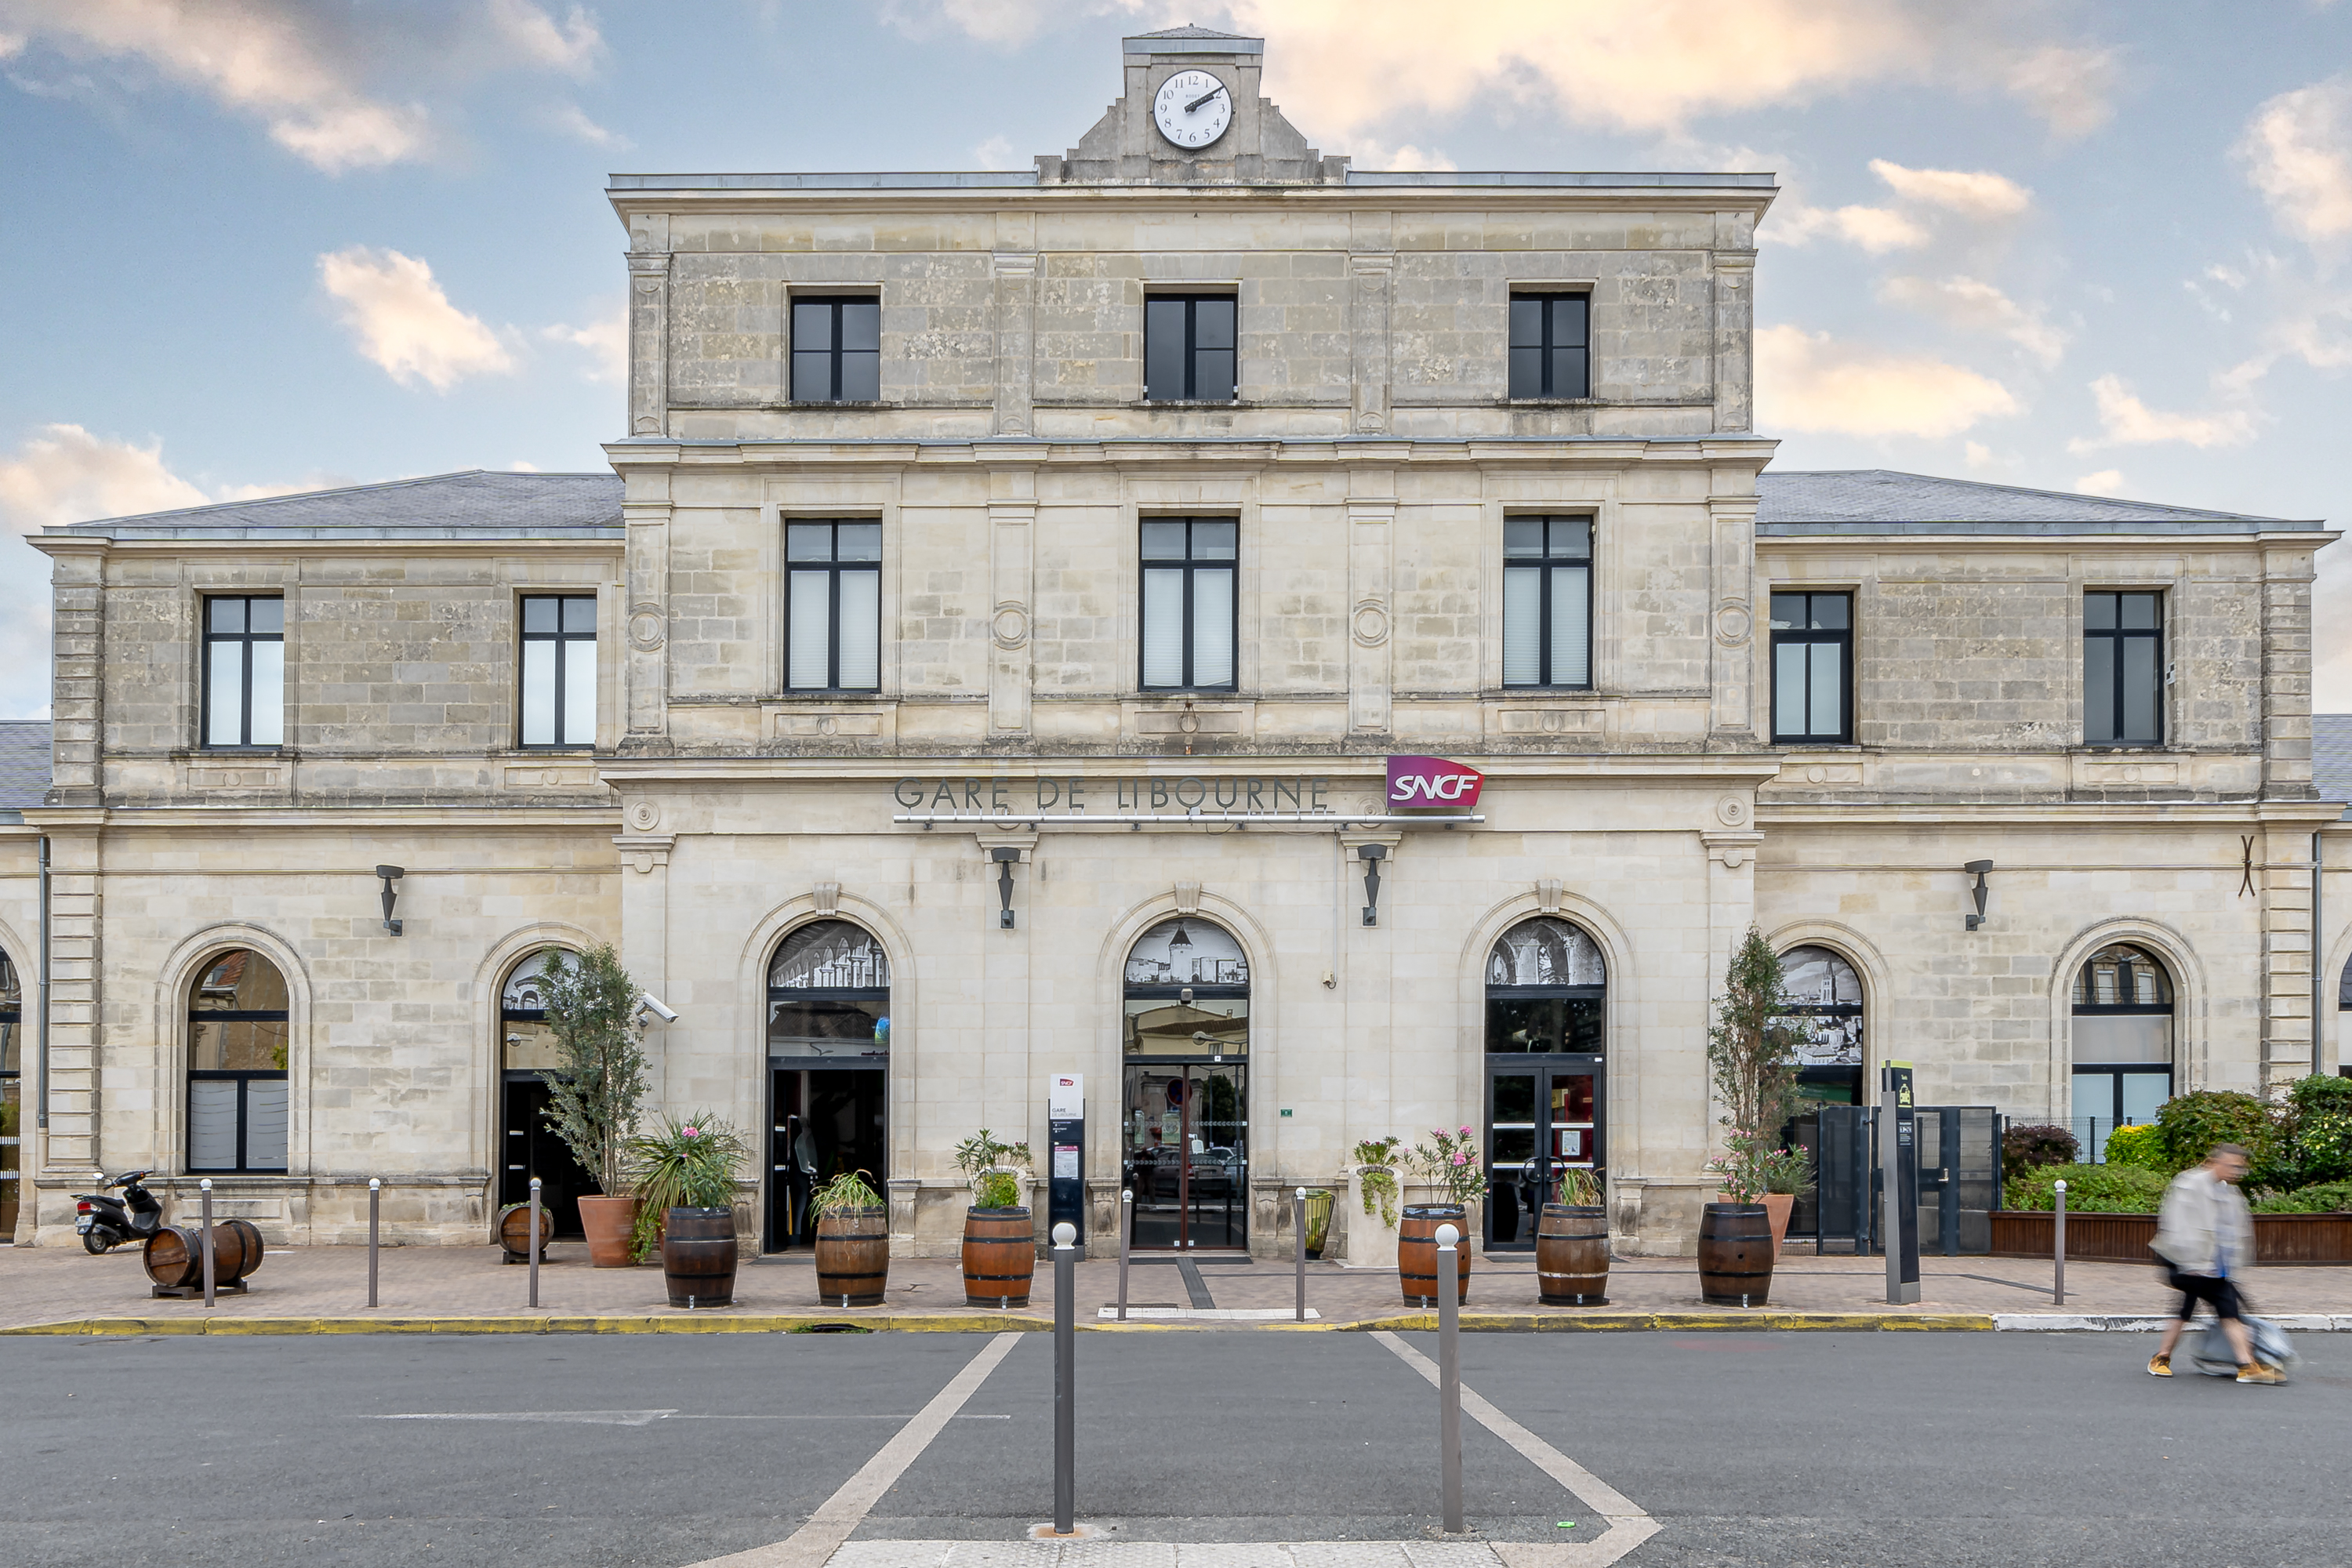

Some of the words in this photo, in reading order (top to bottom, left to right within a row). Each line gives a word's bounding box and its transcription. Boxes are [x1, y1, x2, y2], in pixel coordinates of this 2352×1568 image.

[1175, 79, 1183, 88] 11
[1188, 75, 1199, 85] 12
[1205, 79, 1208, 88] 1
[1163, 89, 1174, 100] 10
[1215, 89, 1221, 99] 2
[1160, 103, 1167, 114] 9
[1219, 103, 1225, 114] 3
[1164, 118, 1171, 128] 8
[1213, 118, 1220, 129] 4
[1176, 129, 1182, 140] 7
[1189, 132, 1196, 143] 6
[1204, 129, 1210, 139] 5
[895, 777, 1008, 808] GARE
[1037, 777, 1085, 808] DE
[1117, 777, 1329, 808] LIBOURNE
[1390, 774, 1479, 800] SNCF
